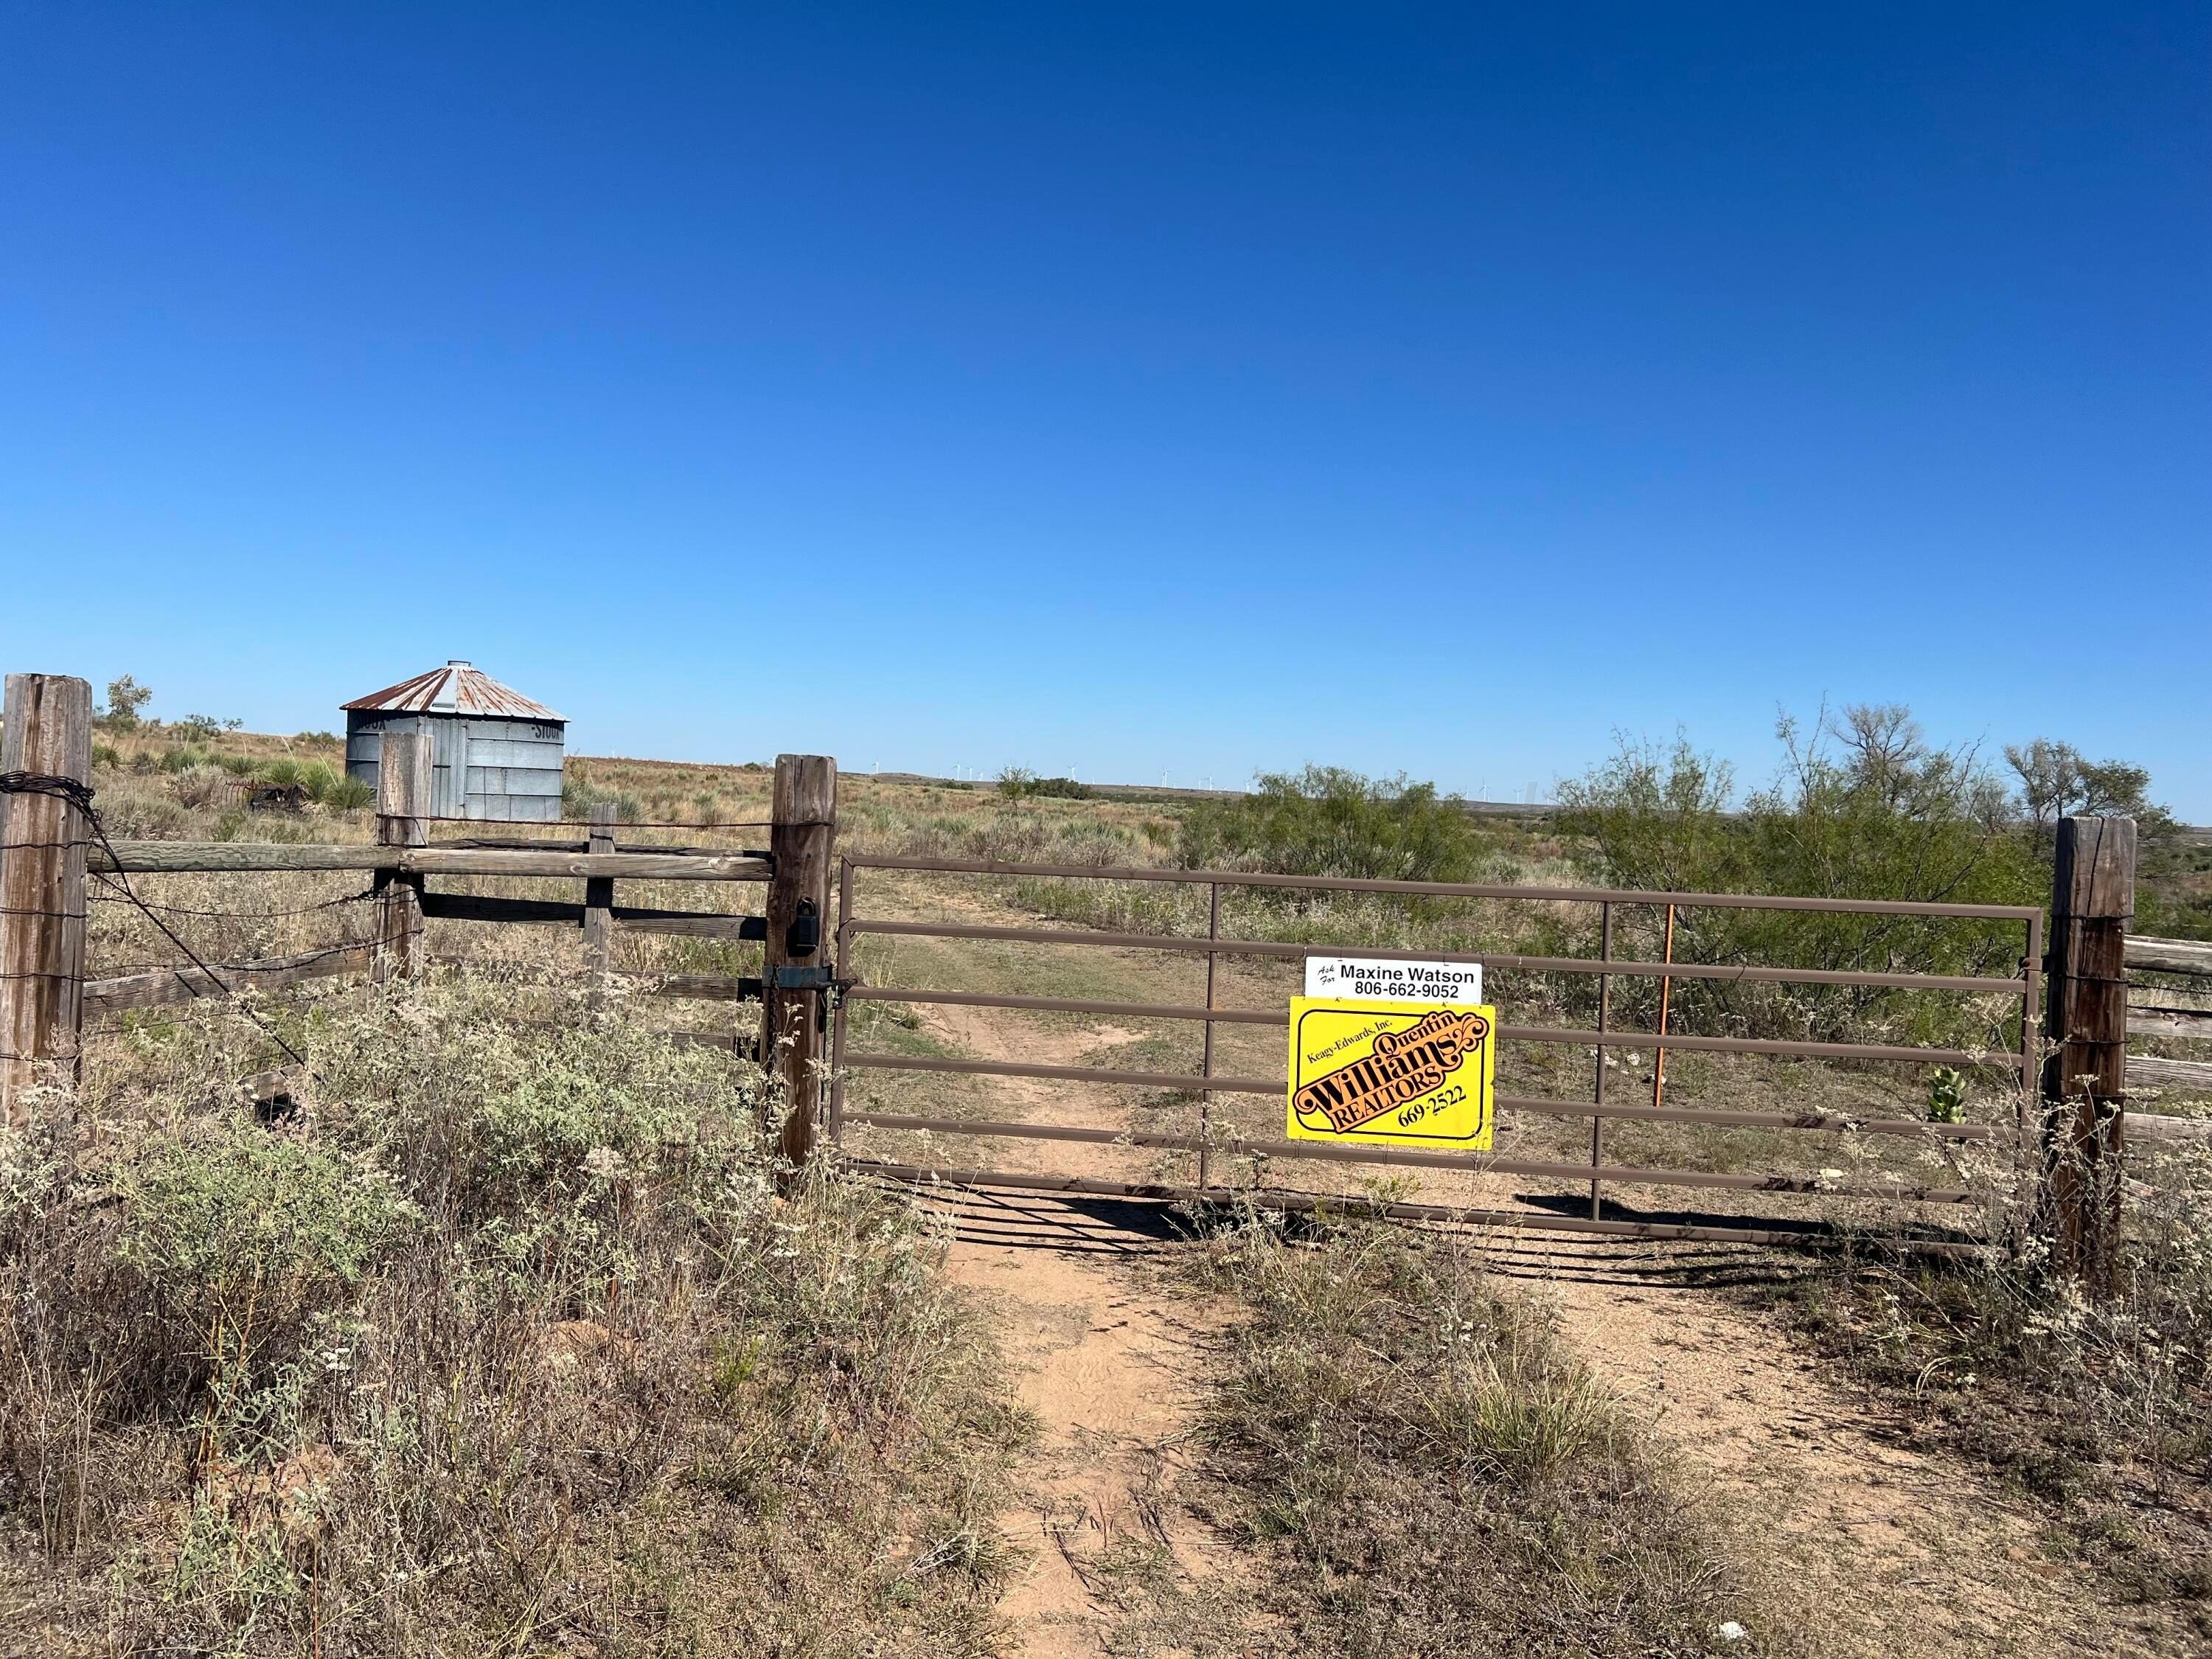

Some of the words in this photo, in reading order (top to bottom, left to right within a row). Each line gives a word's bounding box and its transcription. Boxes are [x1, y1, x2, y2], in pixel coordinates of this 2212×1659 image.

[1318, 964, 1335, 975] Ask
[1320, 976, 1335, 985] For
[1340, 964, 1403, 981] Maxine
[1408, 967, 1475, 984] Watson
[1354, 981, 1458, 998] 806-662-9052
[1307, 1028, 1376, 1064] Keagy-Edwards,
[1374, 1019, 1393, 1033] Inc.
[1378, 1013, 1455, 1059] Quentin
[1297, 1022, 1479, 1111] Williams
[1332, 1065, 1441, 1129] REALTORS
[1398, 1085, 1467, 1127] 669-2522
